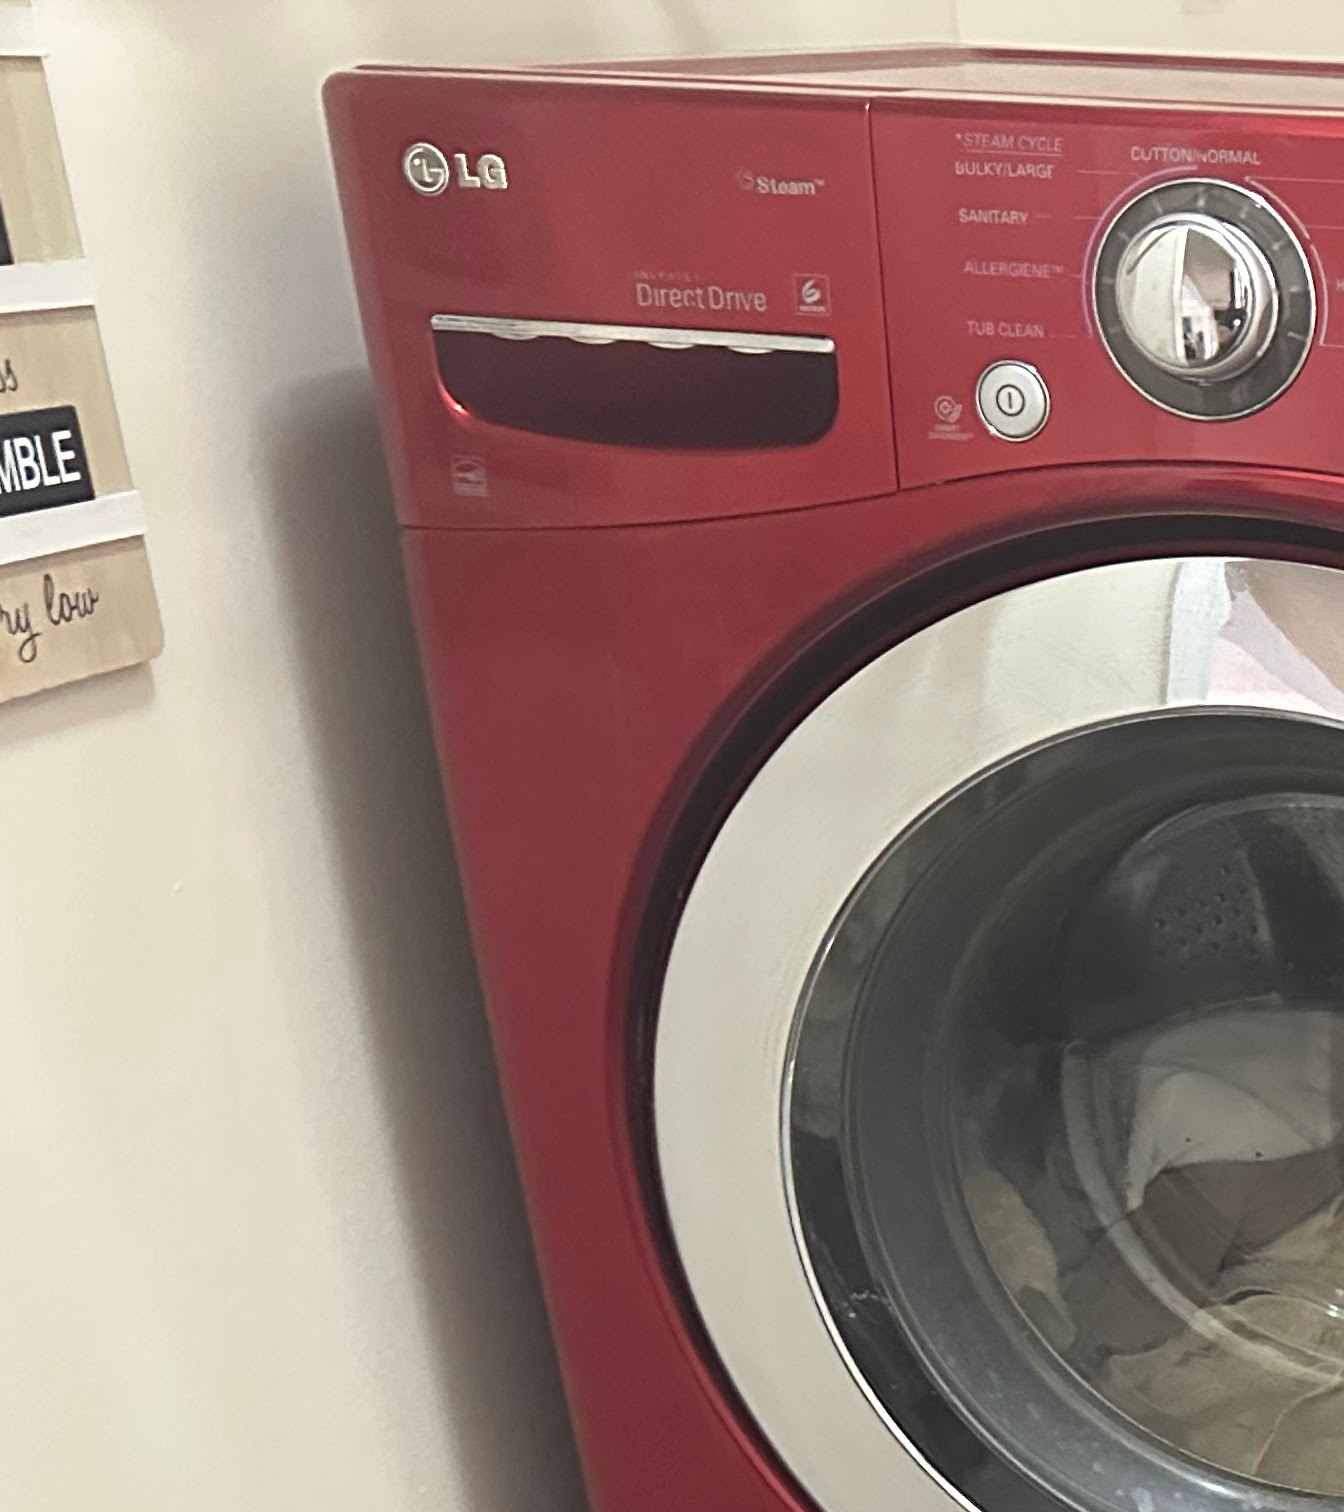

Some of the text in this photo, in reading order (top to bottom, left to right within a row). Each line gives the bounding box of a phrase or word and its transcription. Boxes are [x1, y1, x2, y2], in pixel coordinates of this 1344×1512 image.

[454, 153, 508, 189] LG
[955, 161, 1055, 179] BULKY/LARGE
[959, 208, 1029, 224] SANITARY
[636, 283, 767, 311] Direct Drive
[967, 320, 1044, 338] TUB CLEAN
[44, 573, 99, 625] low
